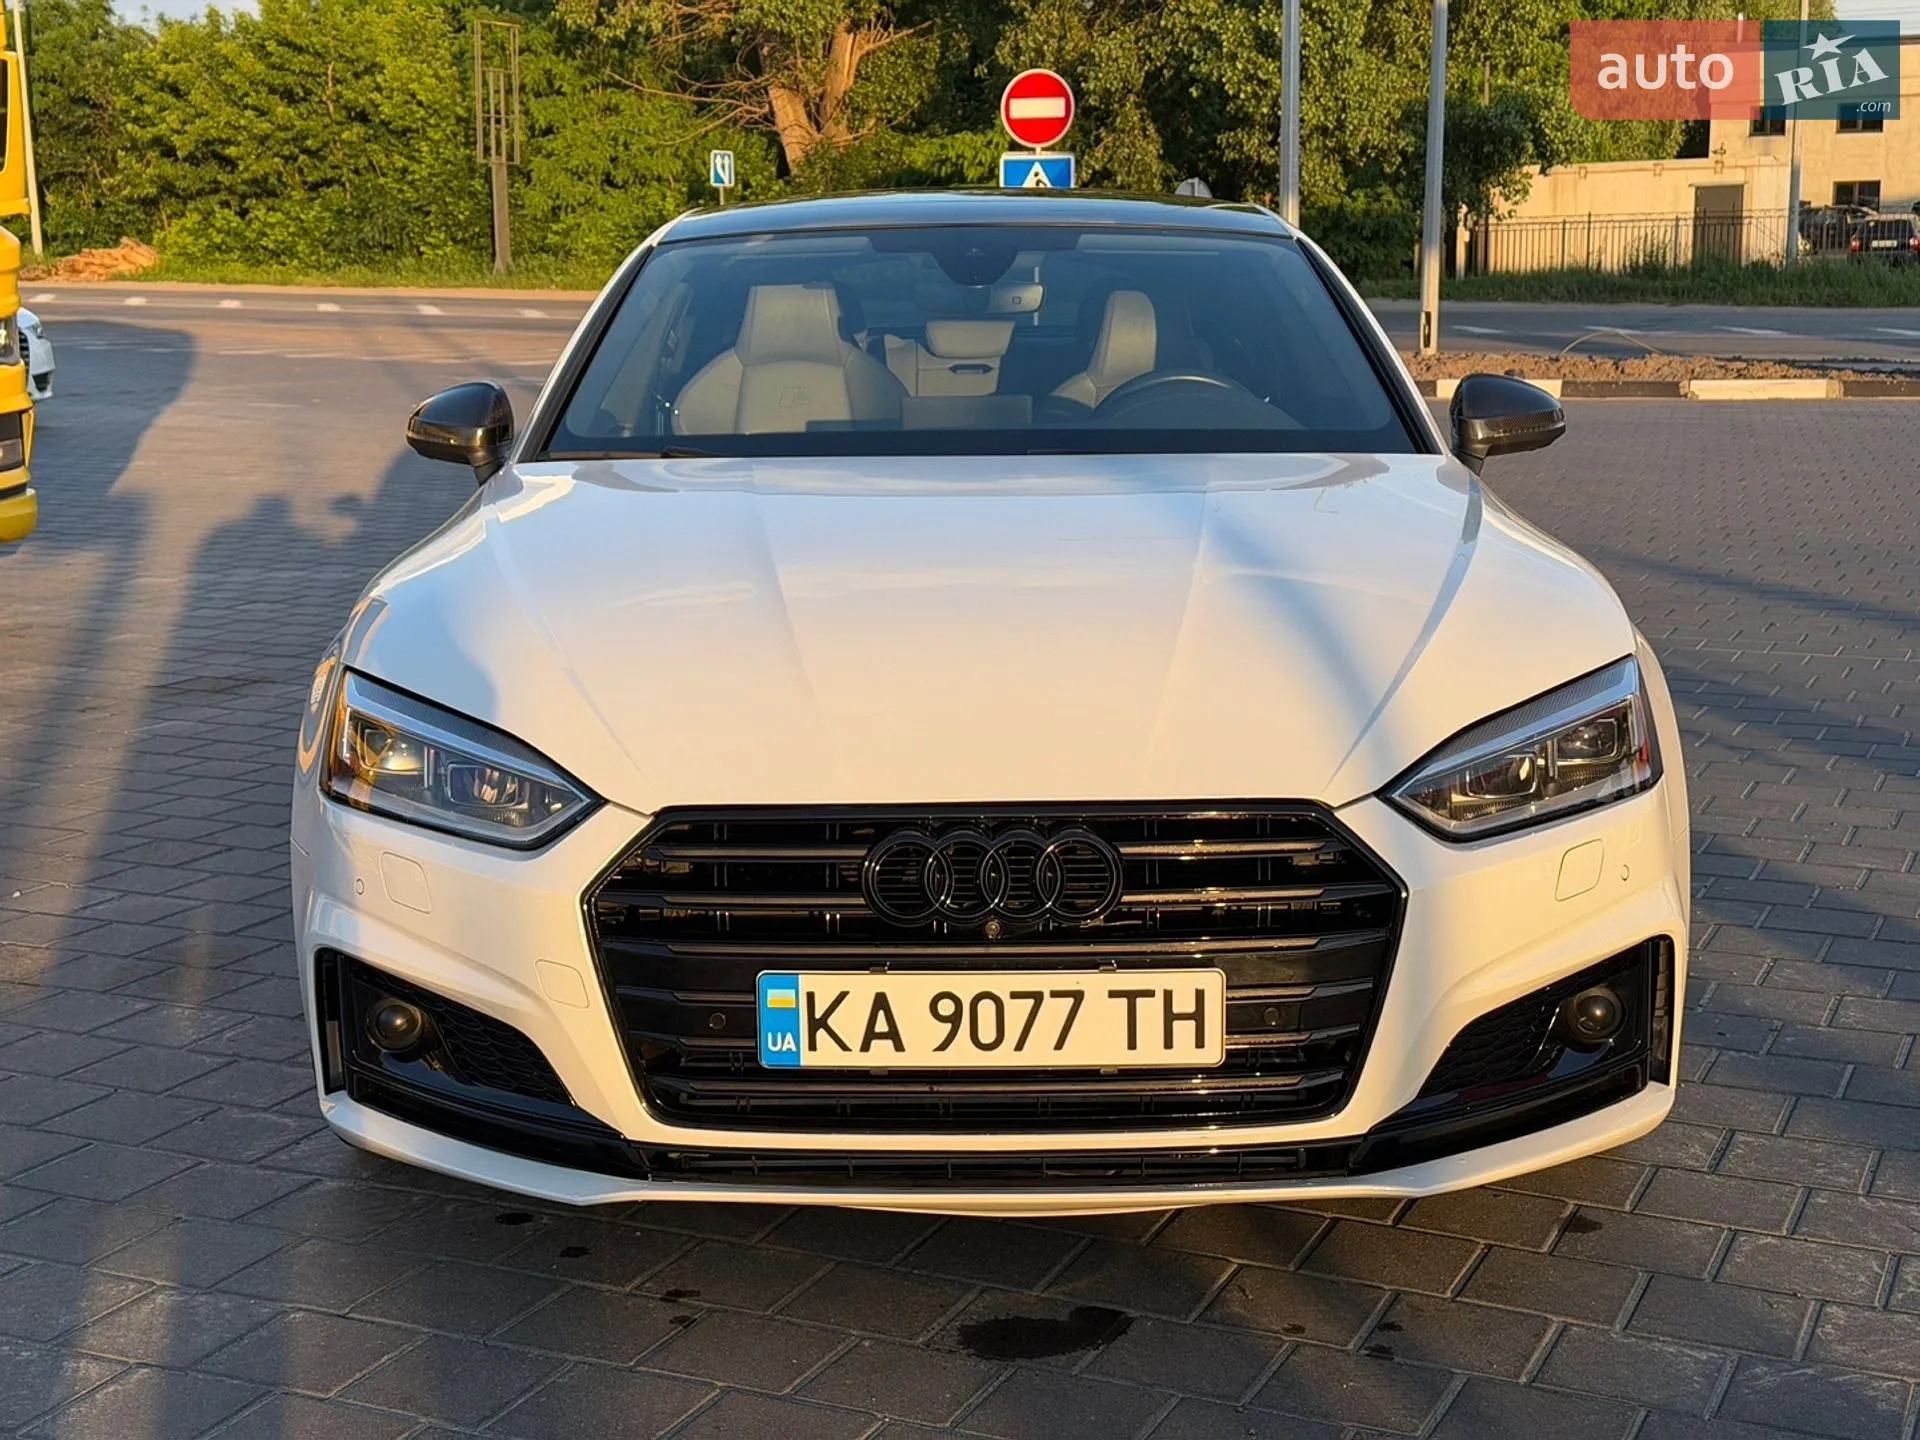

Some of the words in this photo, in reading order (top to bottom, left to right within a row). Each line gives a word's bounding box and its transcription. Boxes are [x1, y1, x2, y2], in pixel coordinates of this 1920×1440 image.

[767, 1031, 797, 1052] UA
[806, 990, 906, 1053] KA
[929, 988, 1085, 1052] 9077
[1107, 988, 1206, 1051] TH
